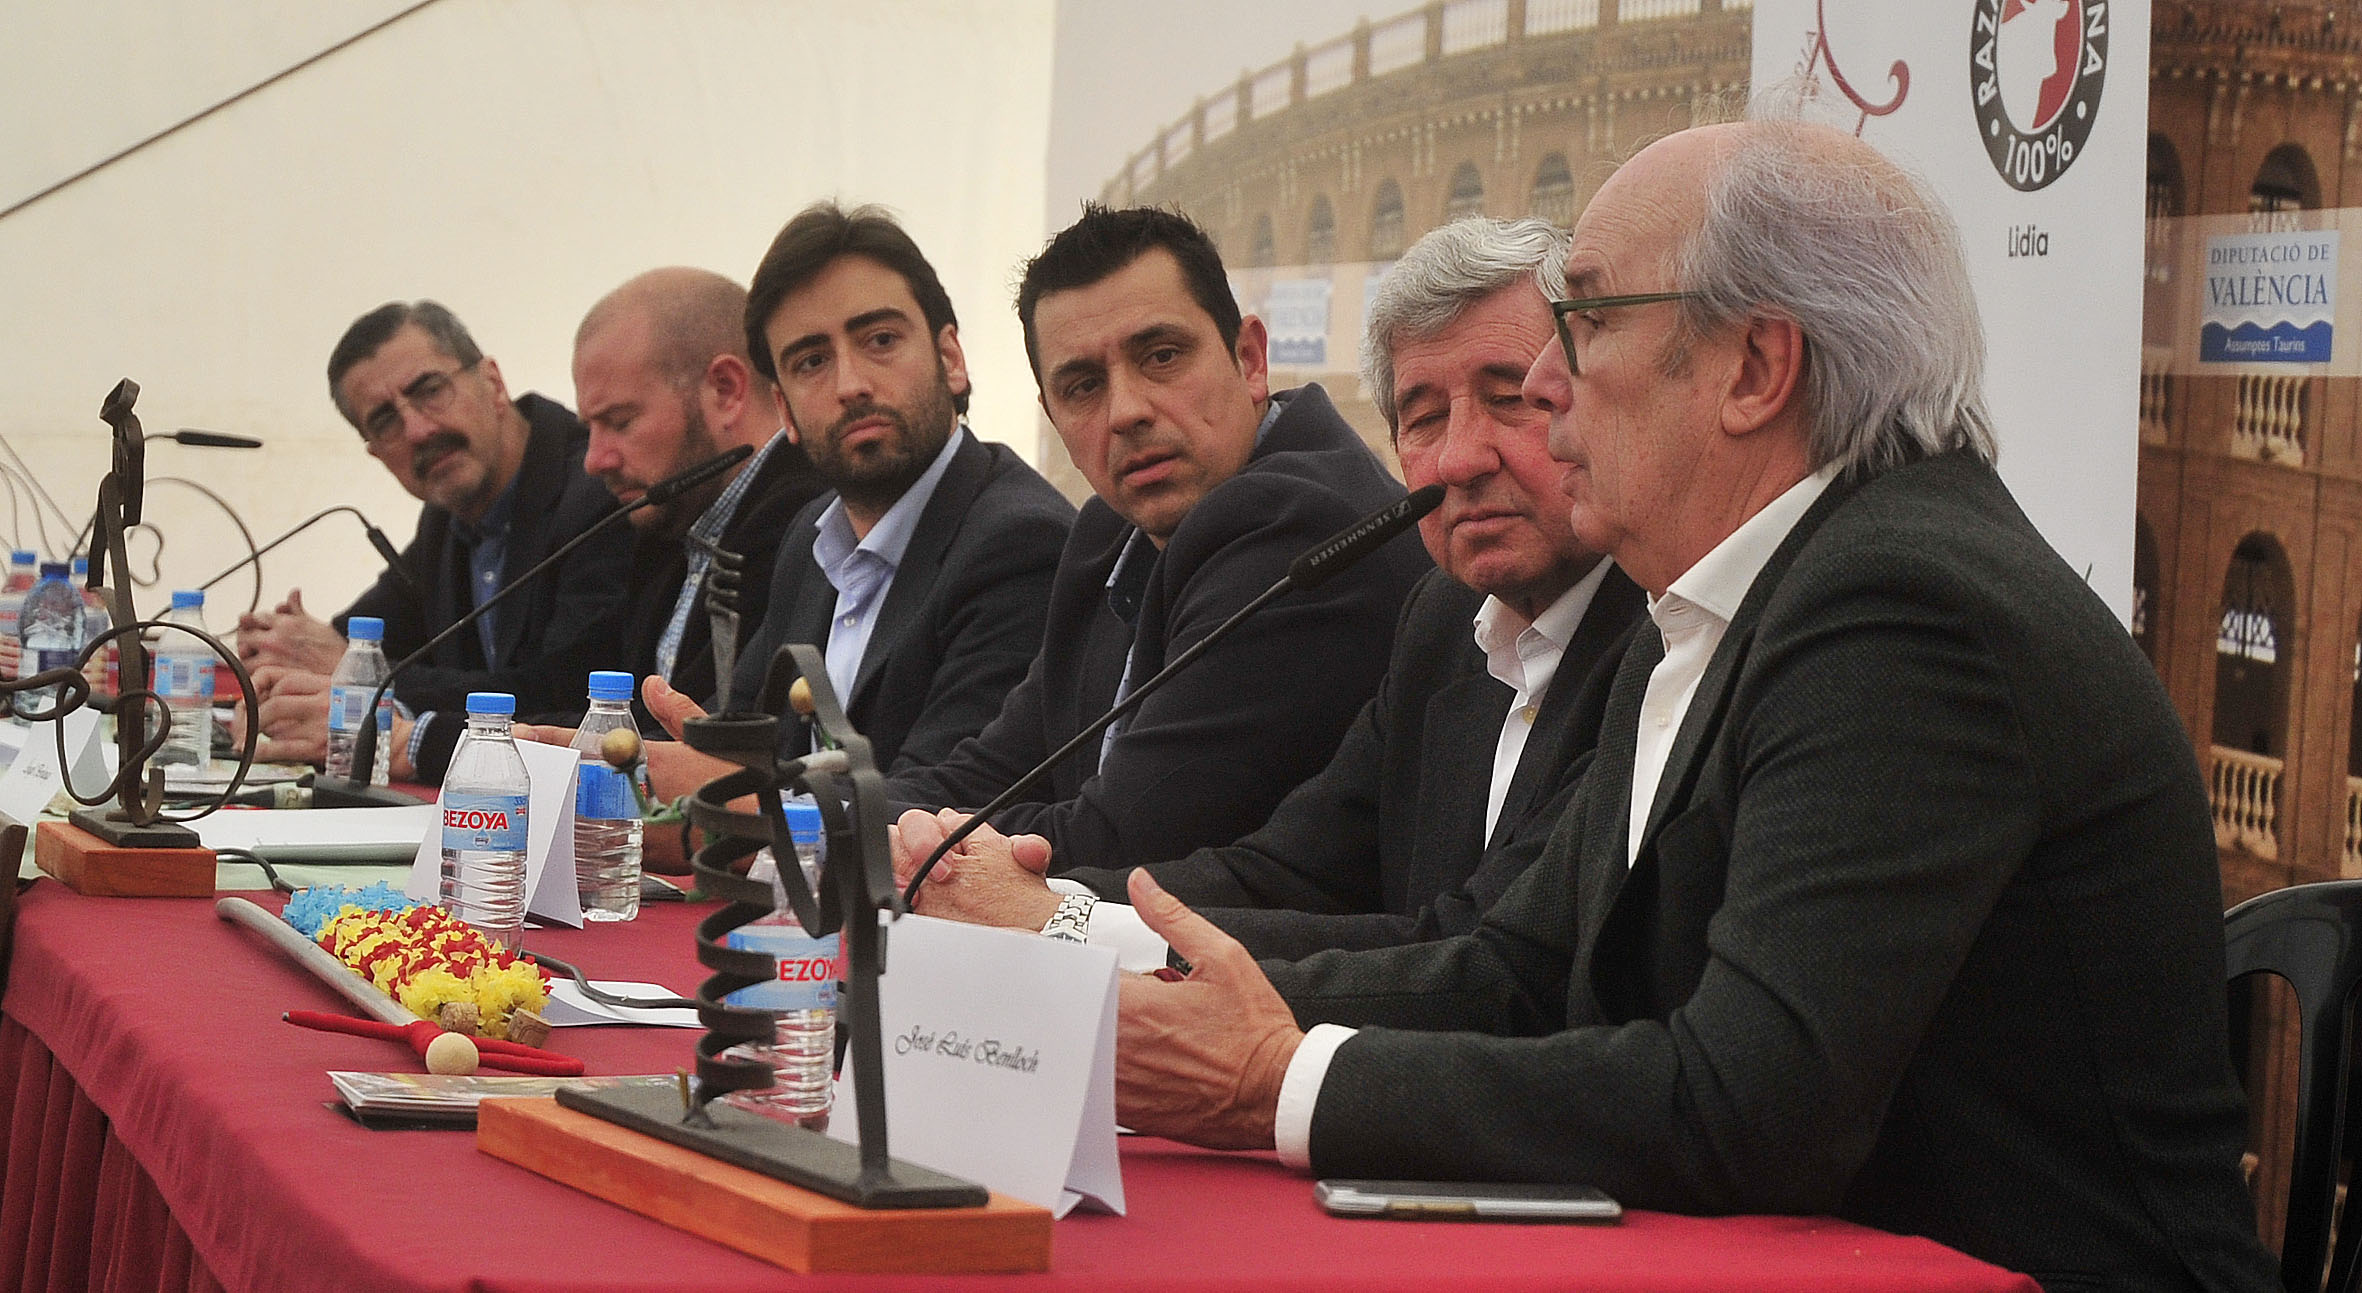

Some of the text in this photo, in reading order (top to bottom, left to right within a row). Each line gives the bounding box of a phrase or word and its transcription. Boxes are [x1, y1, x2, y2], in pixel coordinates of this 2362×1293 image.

[2004, 123, 2073, 184] 100%
[2008, 224, 2049, 257] Lidia
[2210, 242, 2330, 264] DIPUTACIÓ DE
[2209, 268, 2328, 307] VALÈNCIA
[2224, 336, 2305, 357] Assumptes Taurins
[1310, 512, 1391, 566] SENNHEISER
[443, 809, 509, 830] BEZOYA
[895, 1025, 936, 1056] José
